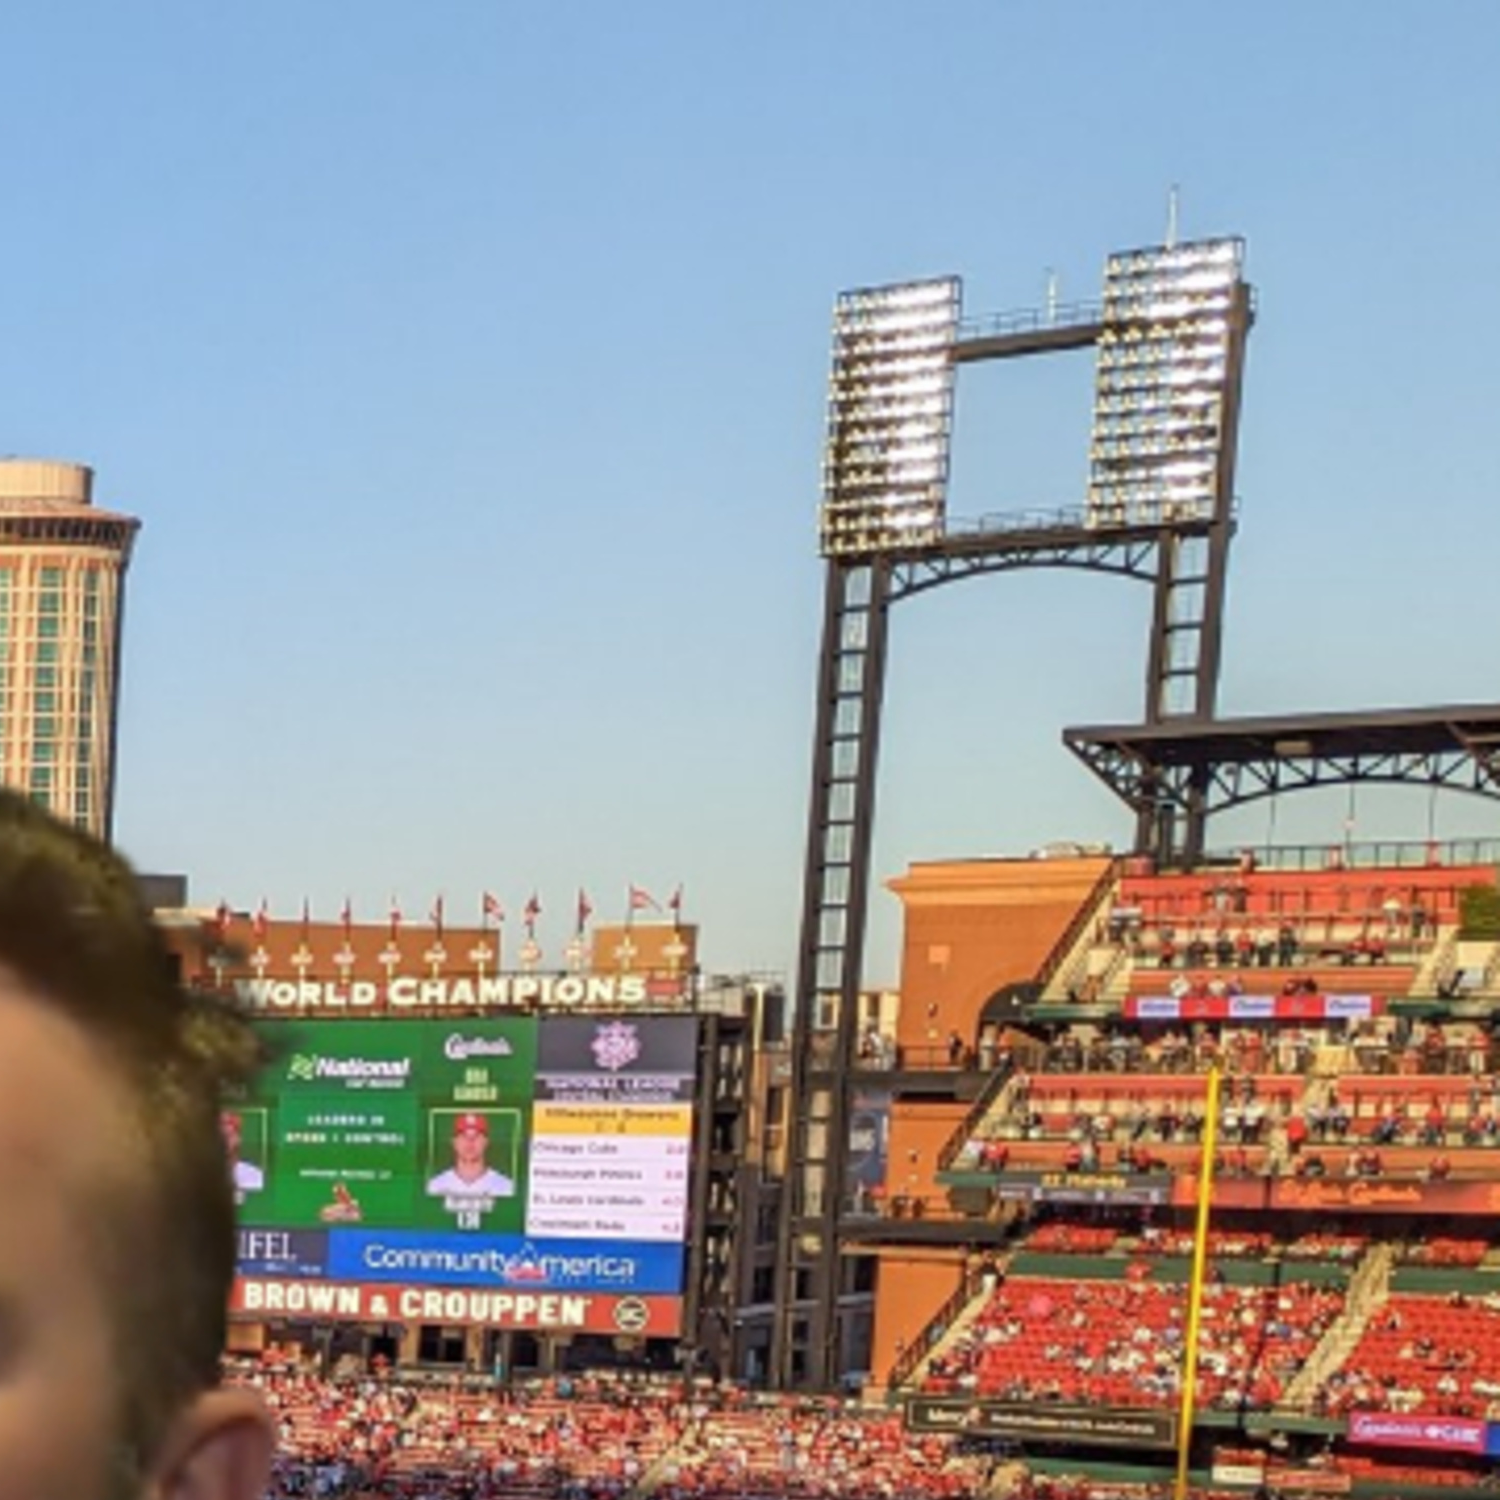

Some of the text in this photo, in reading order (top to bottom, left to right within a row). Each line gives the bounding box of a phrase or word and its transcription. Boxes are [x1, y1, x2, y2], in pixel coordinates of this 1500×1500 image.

[238, 973, 648, 1007] WORLD CHAMPIONS
[315, 1058, 410, 1078] National
[238, 1231, 297, 1260] IFEL
[244, 1281, 360, 1315] BROWN
[370, 1295, 388, 1315] &
[401, 1291, 585, 1326] CROUPPEN
